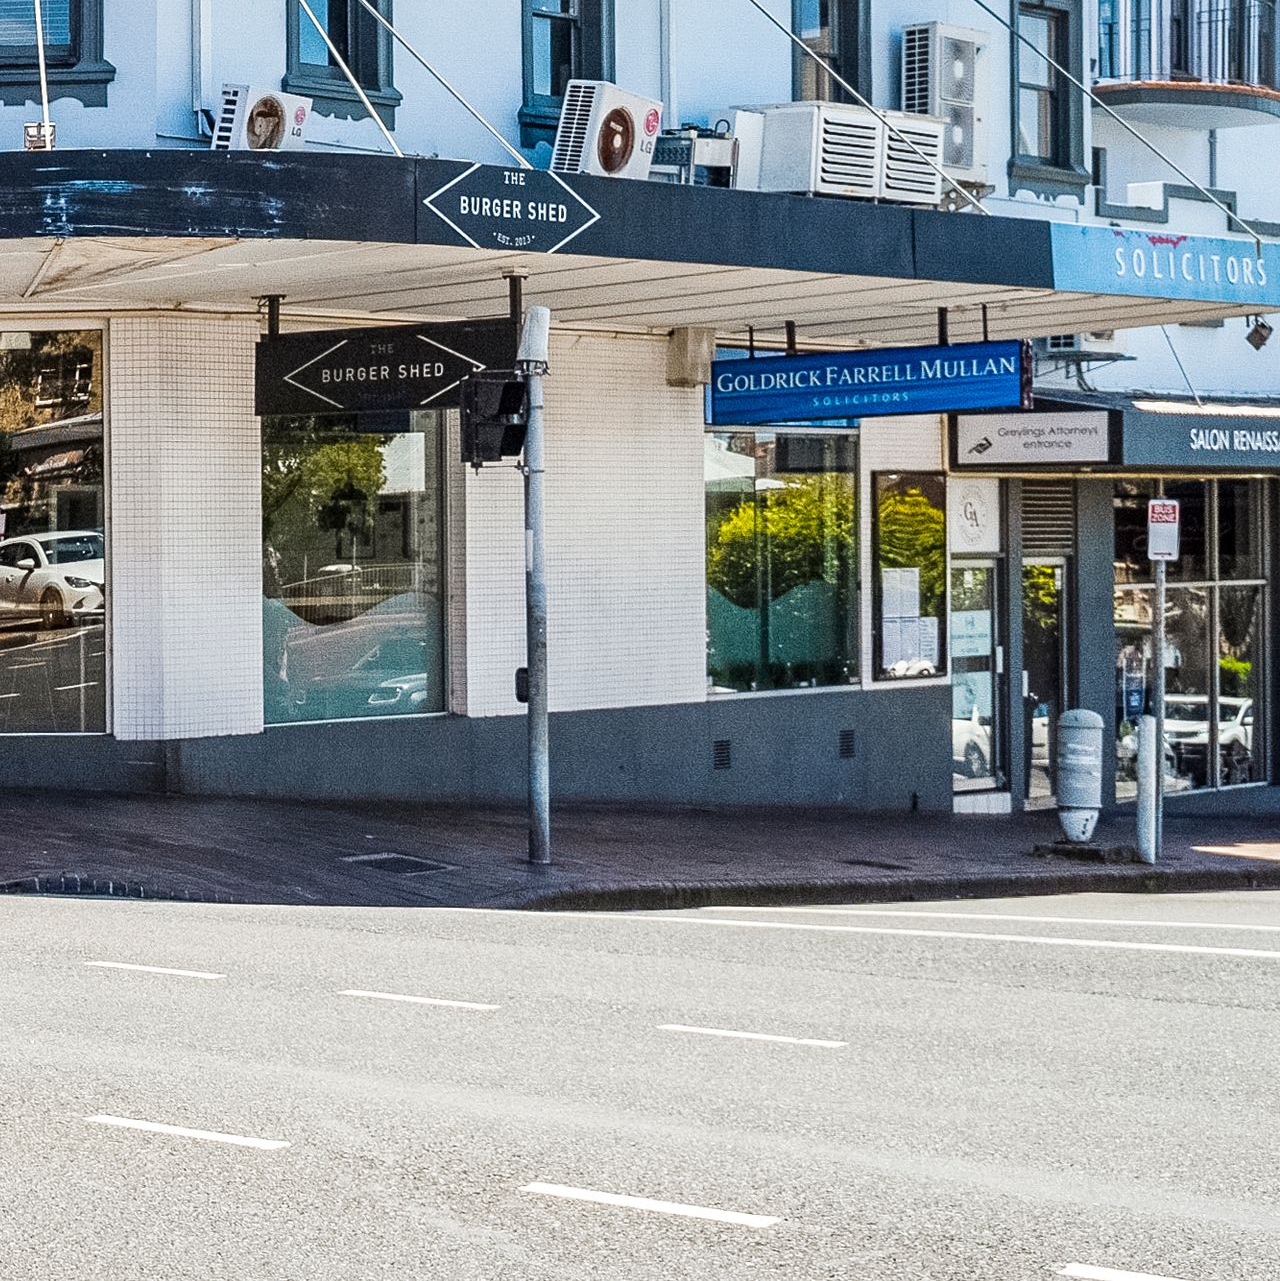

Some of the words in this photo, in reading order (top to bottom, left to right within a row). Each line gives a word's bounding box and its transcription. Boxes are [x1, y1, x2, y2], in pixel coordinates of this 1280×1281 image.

[291, 126, 301, 137] LG
[640, 139, 652, 154] LG
[503, 171, 525, 185] THE
[460, 196, 521, 219] BURGER
[528, 201, 567, 223] SHED
[515, 234, 532, 246] 2013
[1115, 247, 1268, 287] SOLICITORS
[370, 344, 394, 354] THE
[322, 366, 389, 383] BURGER
[398, 363, 444, 379] SHED
[717, 370, 821, 393] GOLDRICK
[826, 364, 917, 386] FARRELL
[920, 356, 1016, 380] MULLAN
[813, 392, 910, 406] SOLICITORS
[1023, 440, 1072, 449] entrance
[1190, 428, 1230, 450] SALON
[1233, 430, 1280, 452] RENAISS
